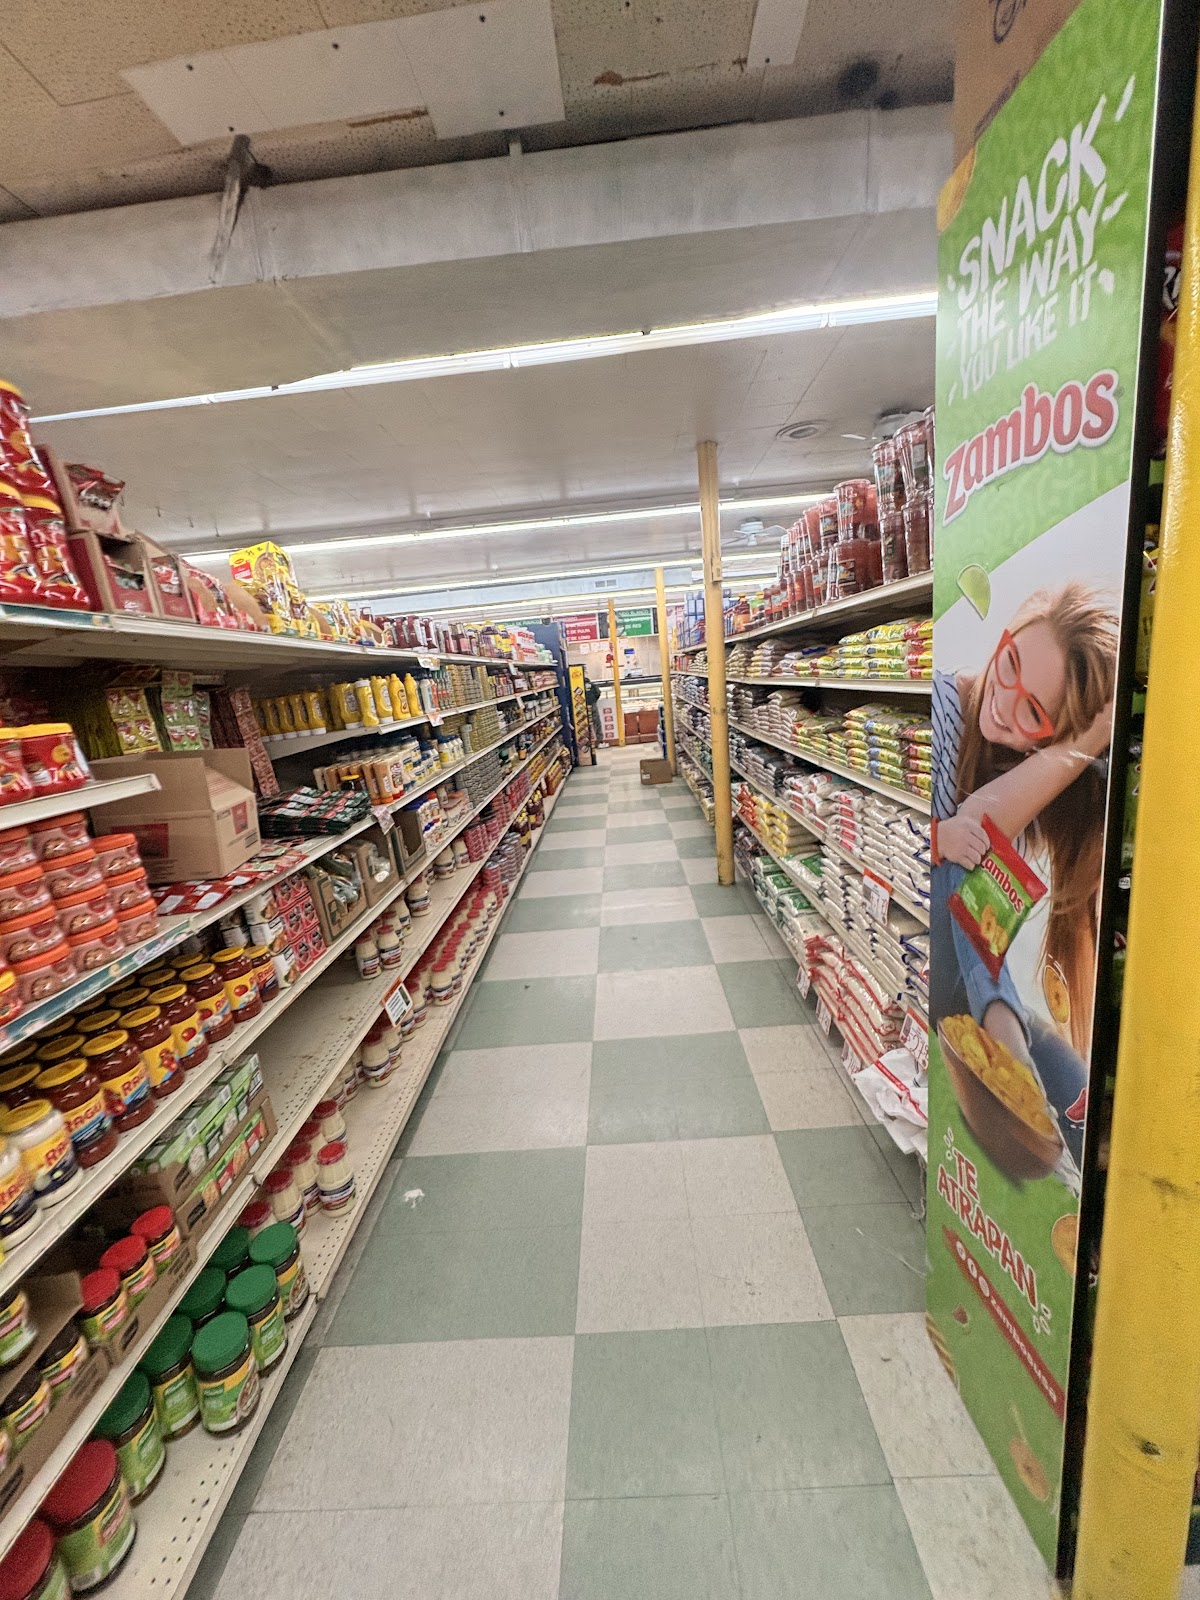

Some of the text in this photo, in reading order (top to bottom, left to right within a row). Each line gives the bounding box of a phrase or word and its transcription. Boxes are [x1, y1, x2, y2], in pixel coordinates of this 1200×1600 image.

[957, 94, 1107, 309] SNACK
[957, 280, 1007, 351] THE
[1019, 183, 1106, 310] WAY
[959, 339, 998, 399] YOU
[1007, 297, 1057, 370] LIKE
[1069, 268, 1099, 324] IT
[937, 1164, 1040, 1313] ATRAPAN
[952, 1147, 981, 1201] TE
